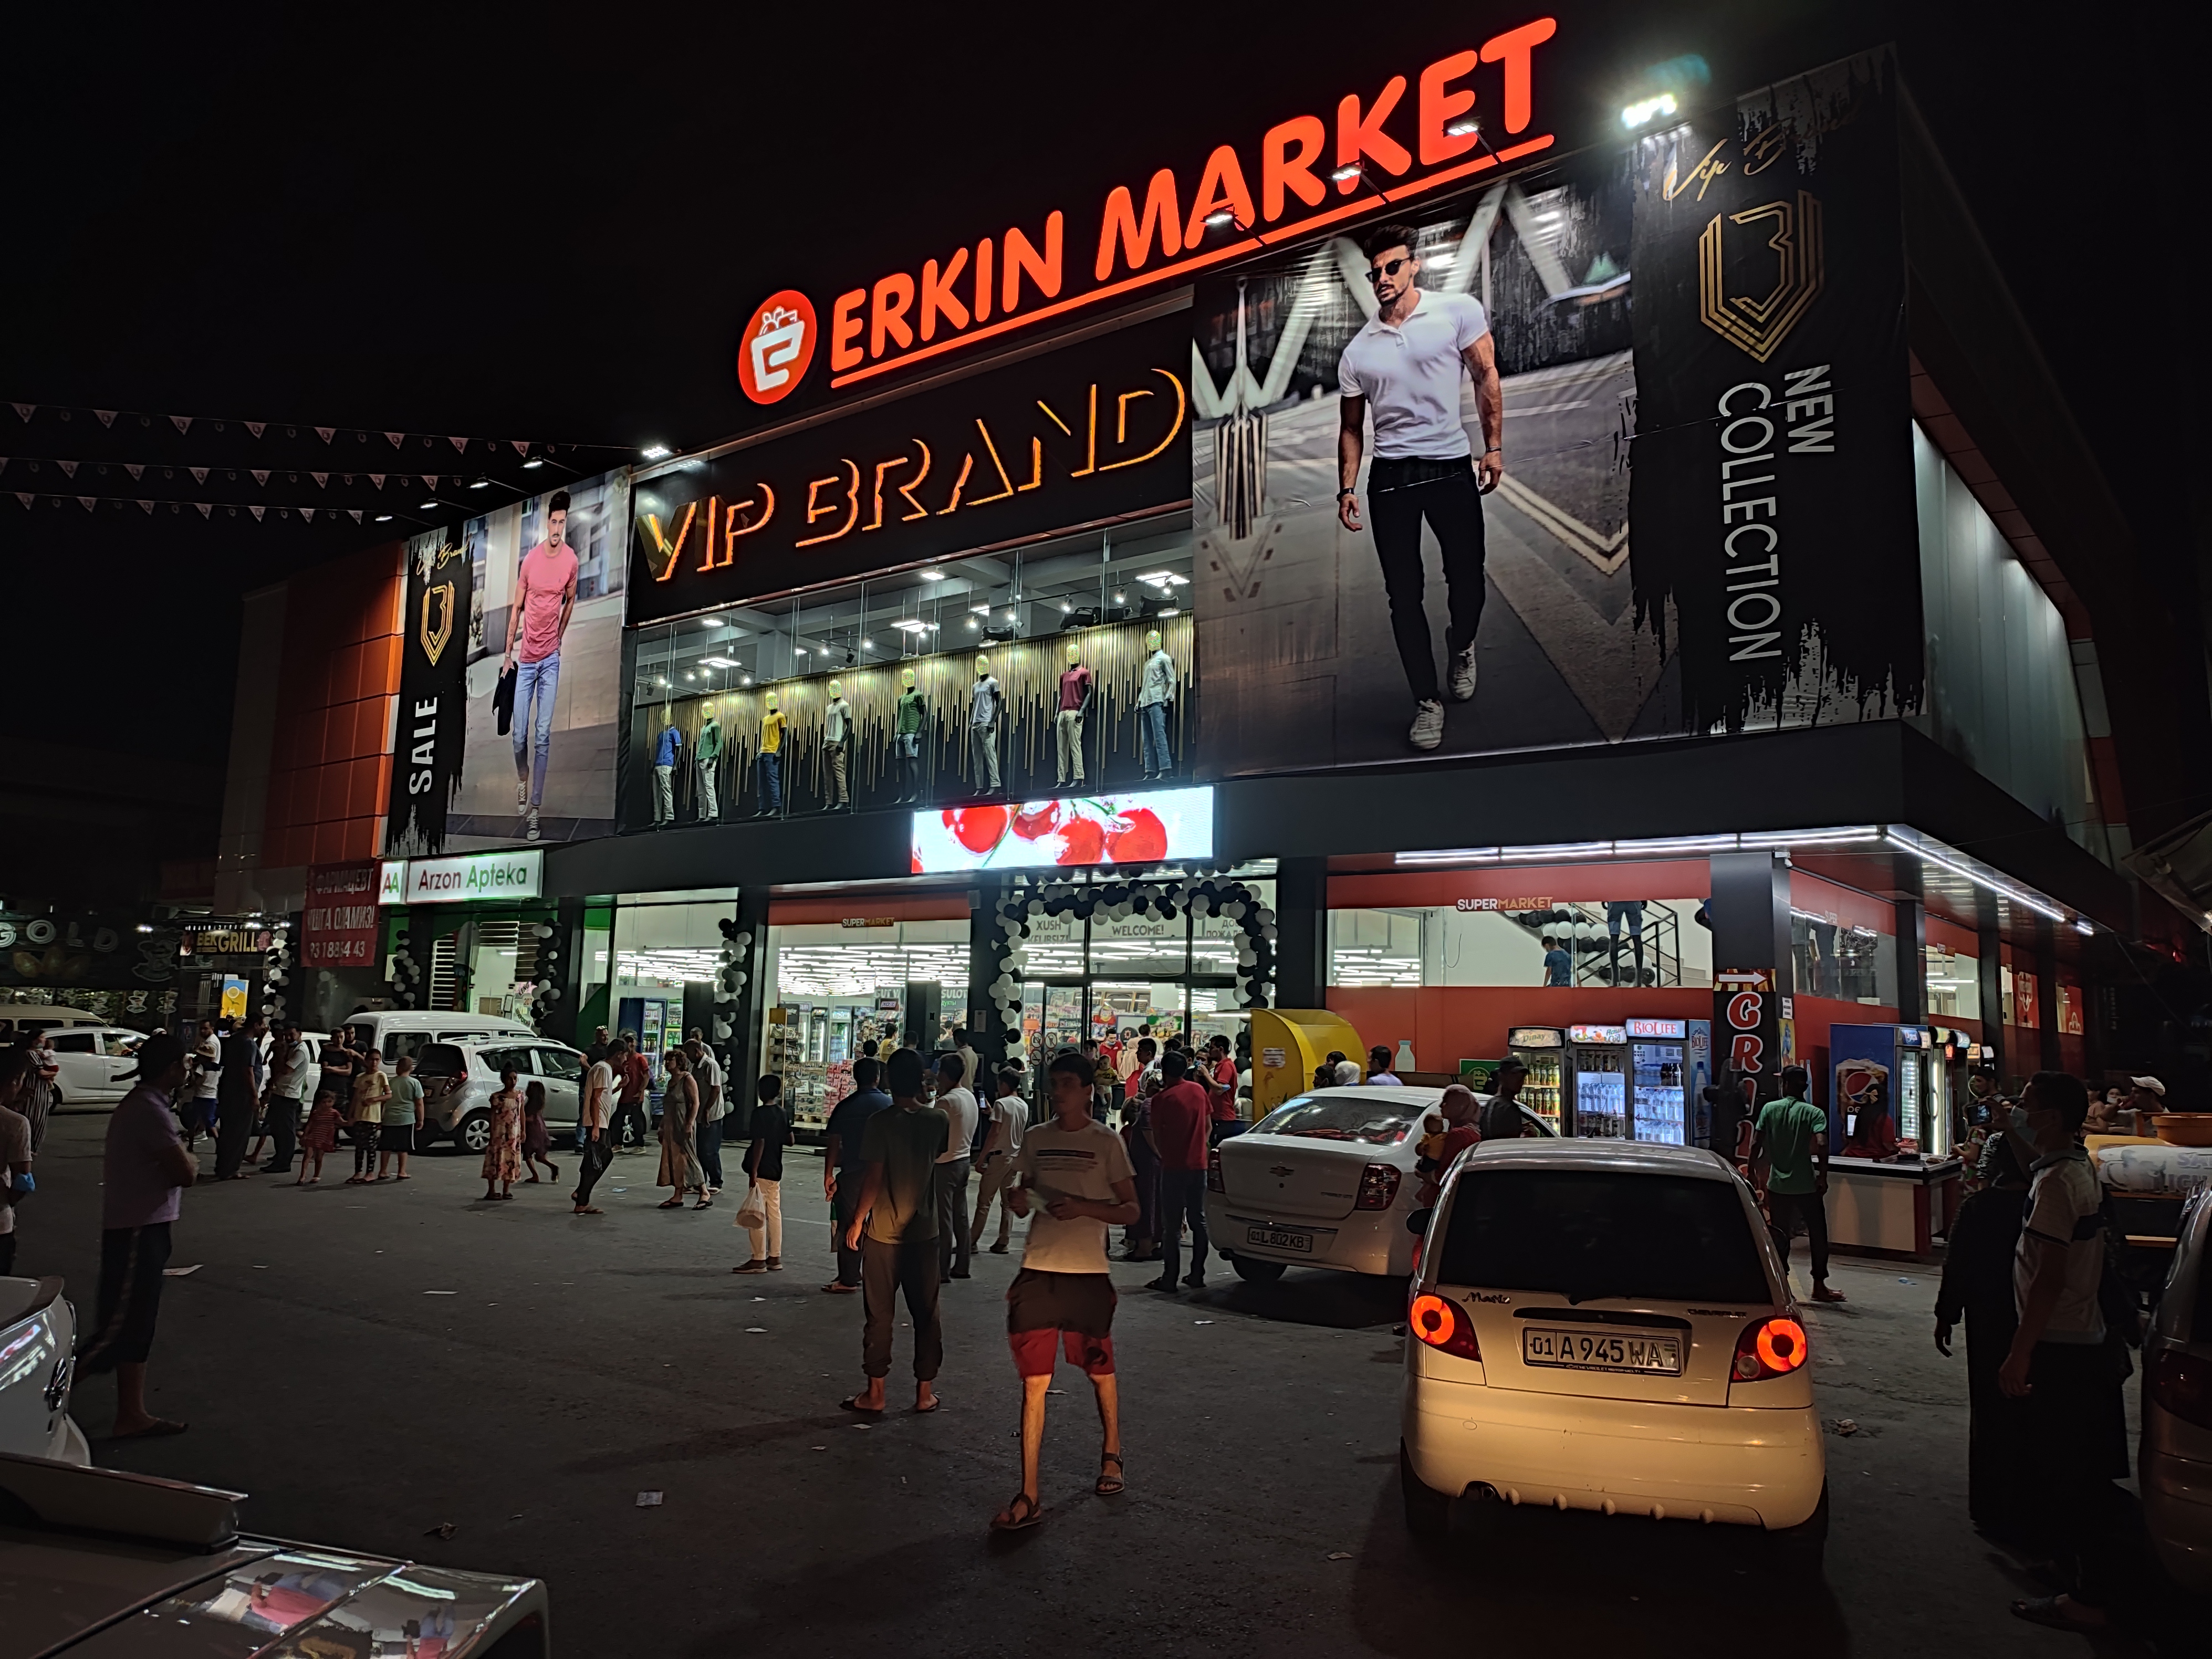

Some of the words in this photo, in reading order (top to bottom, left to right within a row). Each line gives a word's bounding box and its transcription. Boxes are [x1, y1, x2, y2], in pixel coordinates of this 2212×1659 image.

[831, 210, 1063, 373] ERKIN
[1095, 17, 1557, 280] MARKET
[1784, 363, 1835, 453] NEW
[635, 482, 775, 582] VIP
[795, 368, 1187, 549] BRAND
[1718, 382, 1783, 661] COLLECTION
[409, 697, 438, 795] SALE
[382, 872, 400, 894] AA
[418, 869, 462, 891] Arzon
[466, 862, 528, 893] Apteka
[1457, 896, 1553, 910] SUPERMARKET
[842, 917, 895, 927] SUPERMARKET
[1036, 920, 1061, 931] XUSH
[1112, 925, 1164, 937] WELCOME!
[218, 931, 258, 952] GRILL
[1532, 1337, 1554, 1355] 01
[1560, 1336, 1575, 1360] A
[1580, 1337, 1625, 1363] 945
[1627, 1340, 1663, 1367] WA
